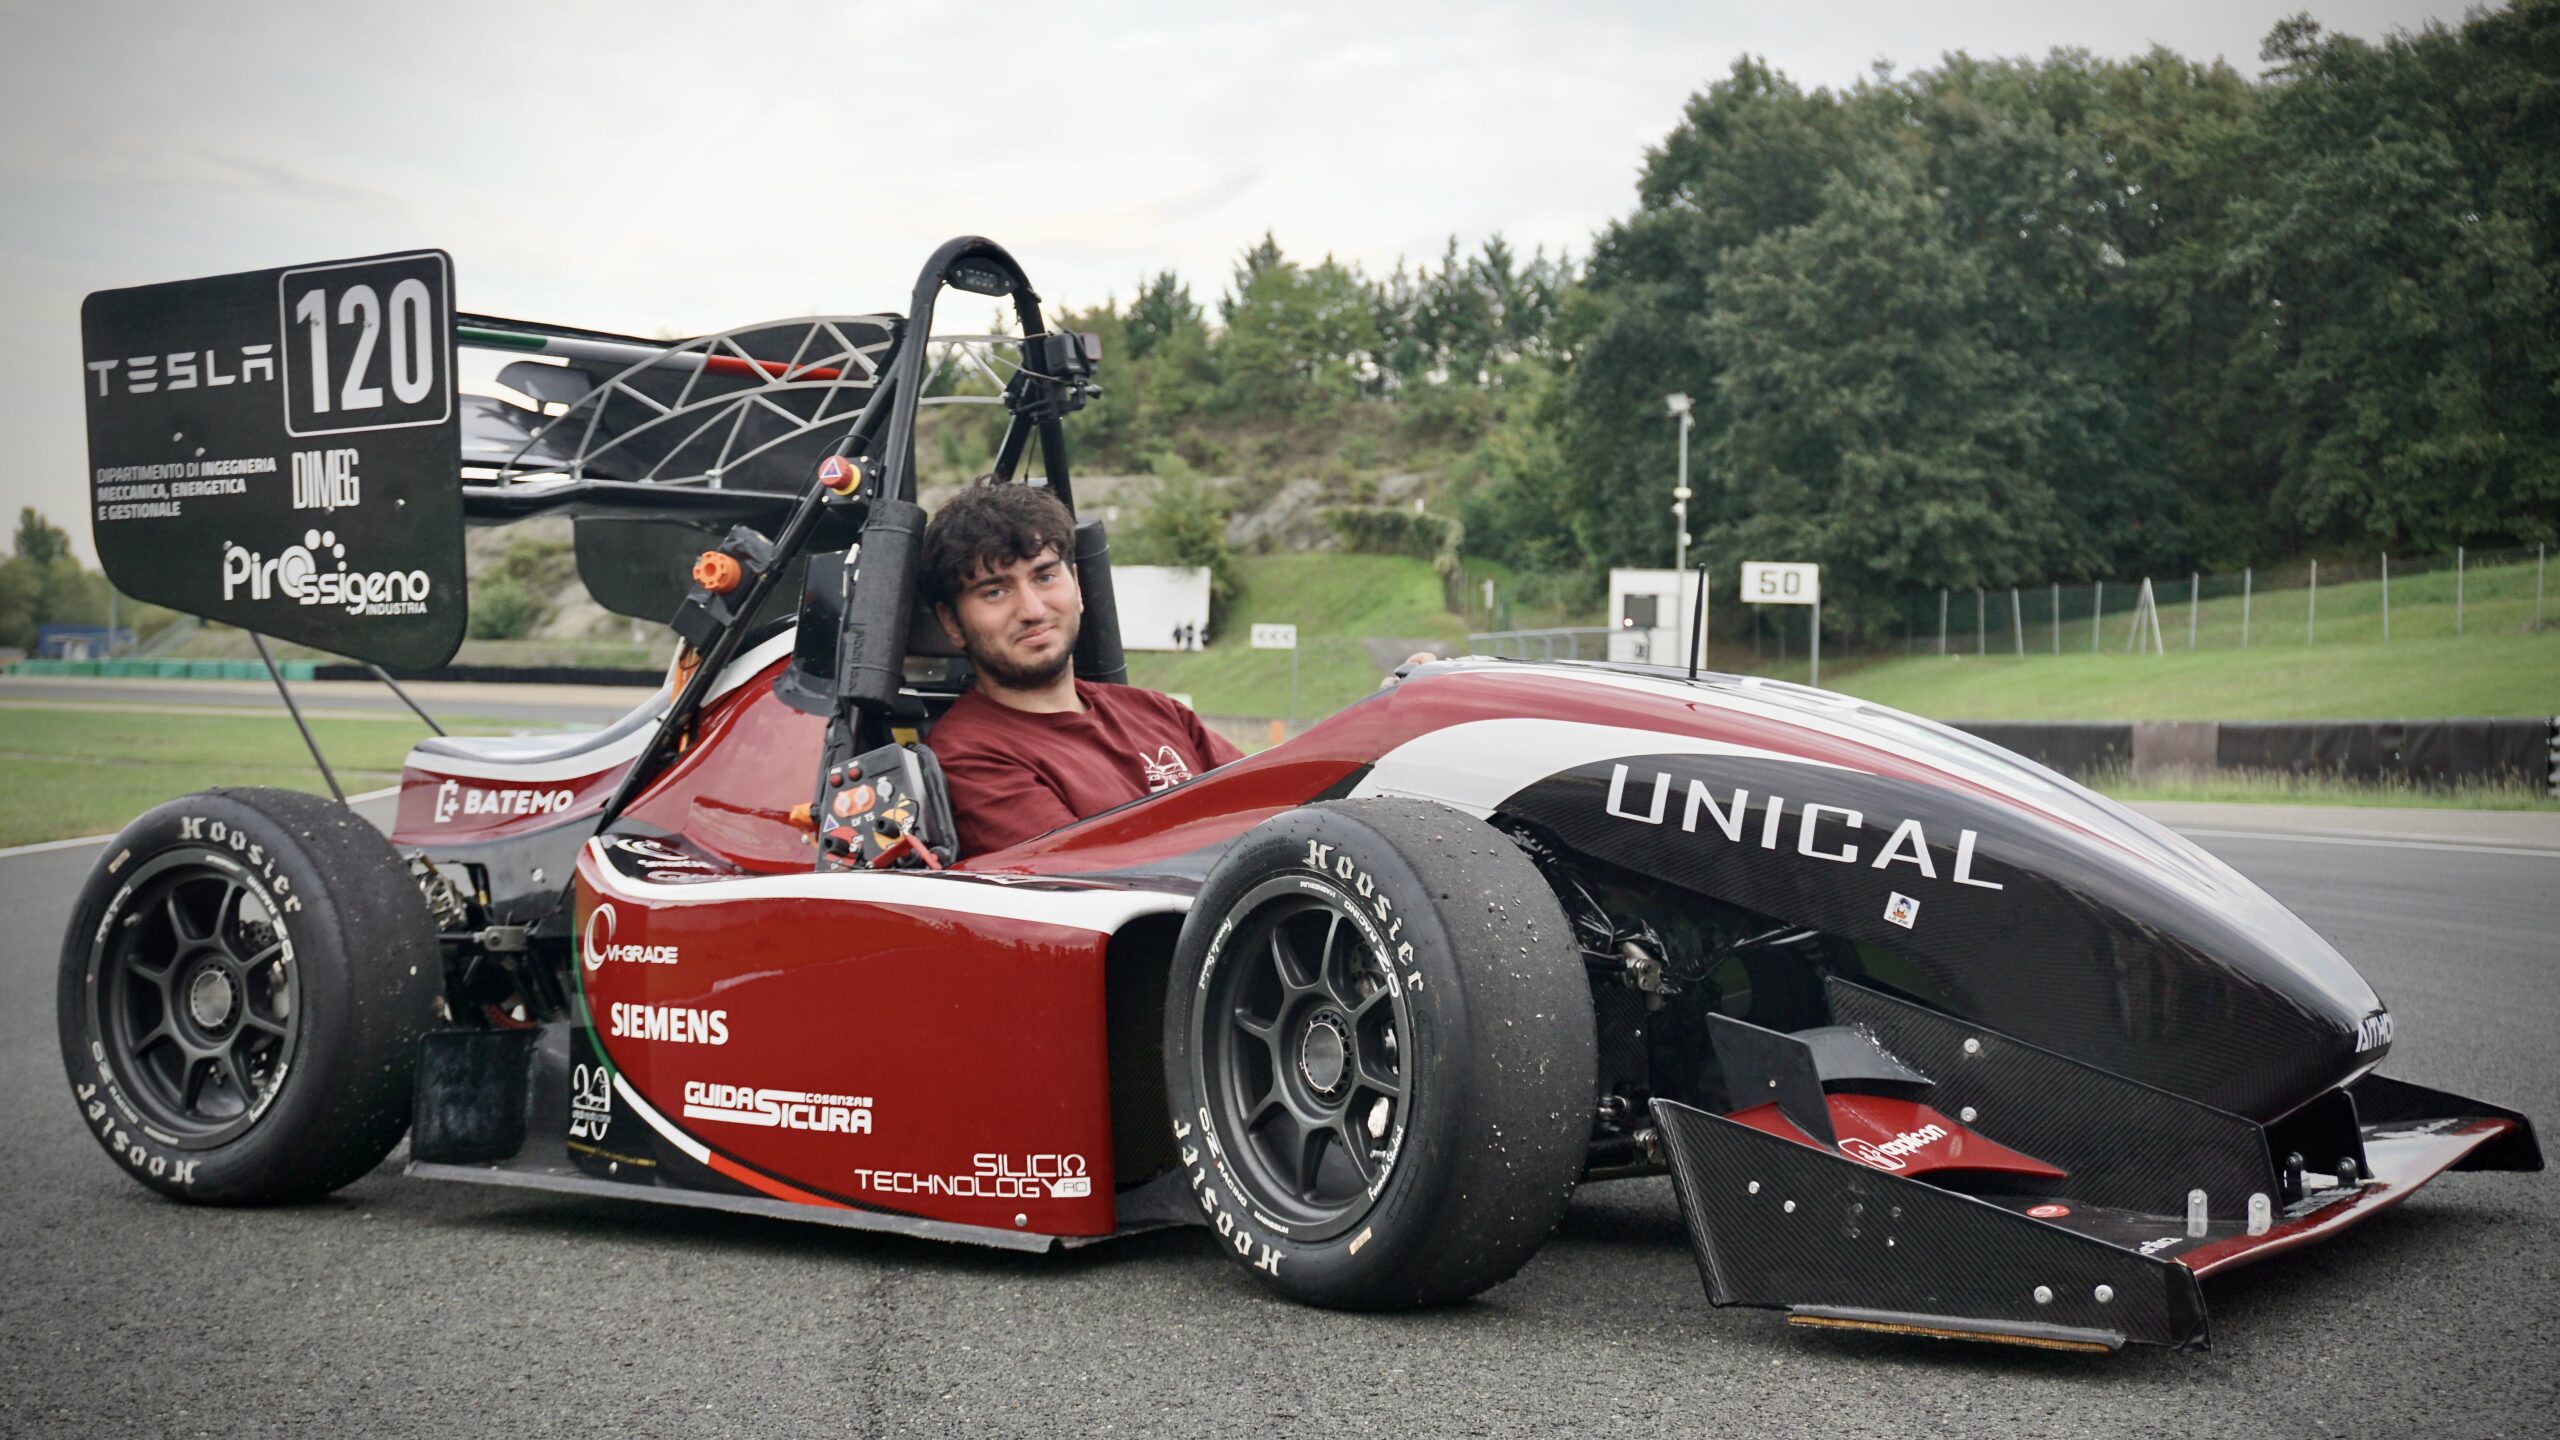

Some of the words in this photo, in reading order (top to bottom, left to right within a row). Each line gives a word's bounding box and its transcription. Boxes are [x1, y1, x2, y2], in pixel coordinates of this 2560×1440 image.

[296, 278, 434, 414] 120
[87, 343, 274, 397] TESLA
[97, 463, 185, 483] DIPARTIMENTO
[186, 462, 199, 478] DI
[201, 457, 277, 477] INGEGNERIA
[97, 482, 170, 502] MECCANICA,
[171, 478, 247, 498] ENERGETICA
[292, 448, 360, 510] DIMEG
[98, 506, 107, 521] E
[108, 502, 182, 520] GESTIONALE
[1760, 570, 1801, 595] 50
[365, 602, 427, 616] INDUSTRIA
[464, 789, 574, 815] BATEMO
[1606, 763, 2004, 890] UNICAL
[178, 816, 302, 912] Hoosier
[1302, 839, 1424, 992] Hoosier
[1343, 900, 1378, 943] RACING
[611, 1002, 729, 1046] SIEMENS
[684, 1080, 755, 1110] GUIDA
[754, 1088, 872, 1134] SICURA
[77, 1083, 201, 1184] Hoosier
[1878, 1123, 1947, 1157] applicon
[854, 1169, 1056, 1198] TECHNOLOGY
[1173, 1119, 1287, 1277] Hoosier
[1217, 1161, 1248, 1208] RACING
